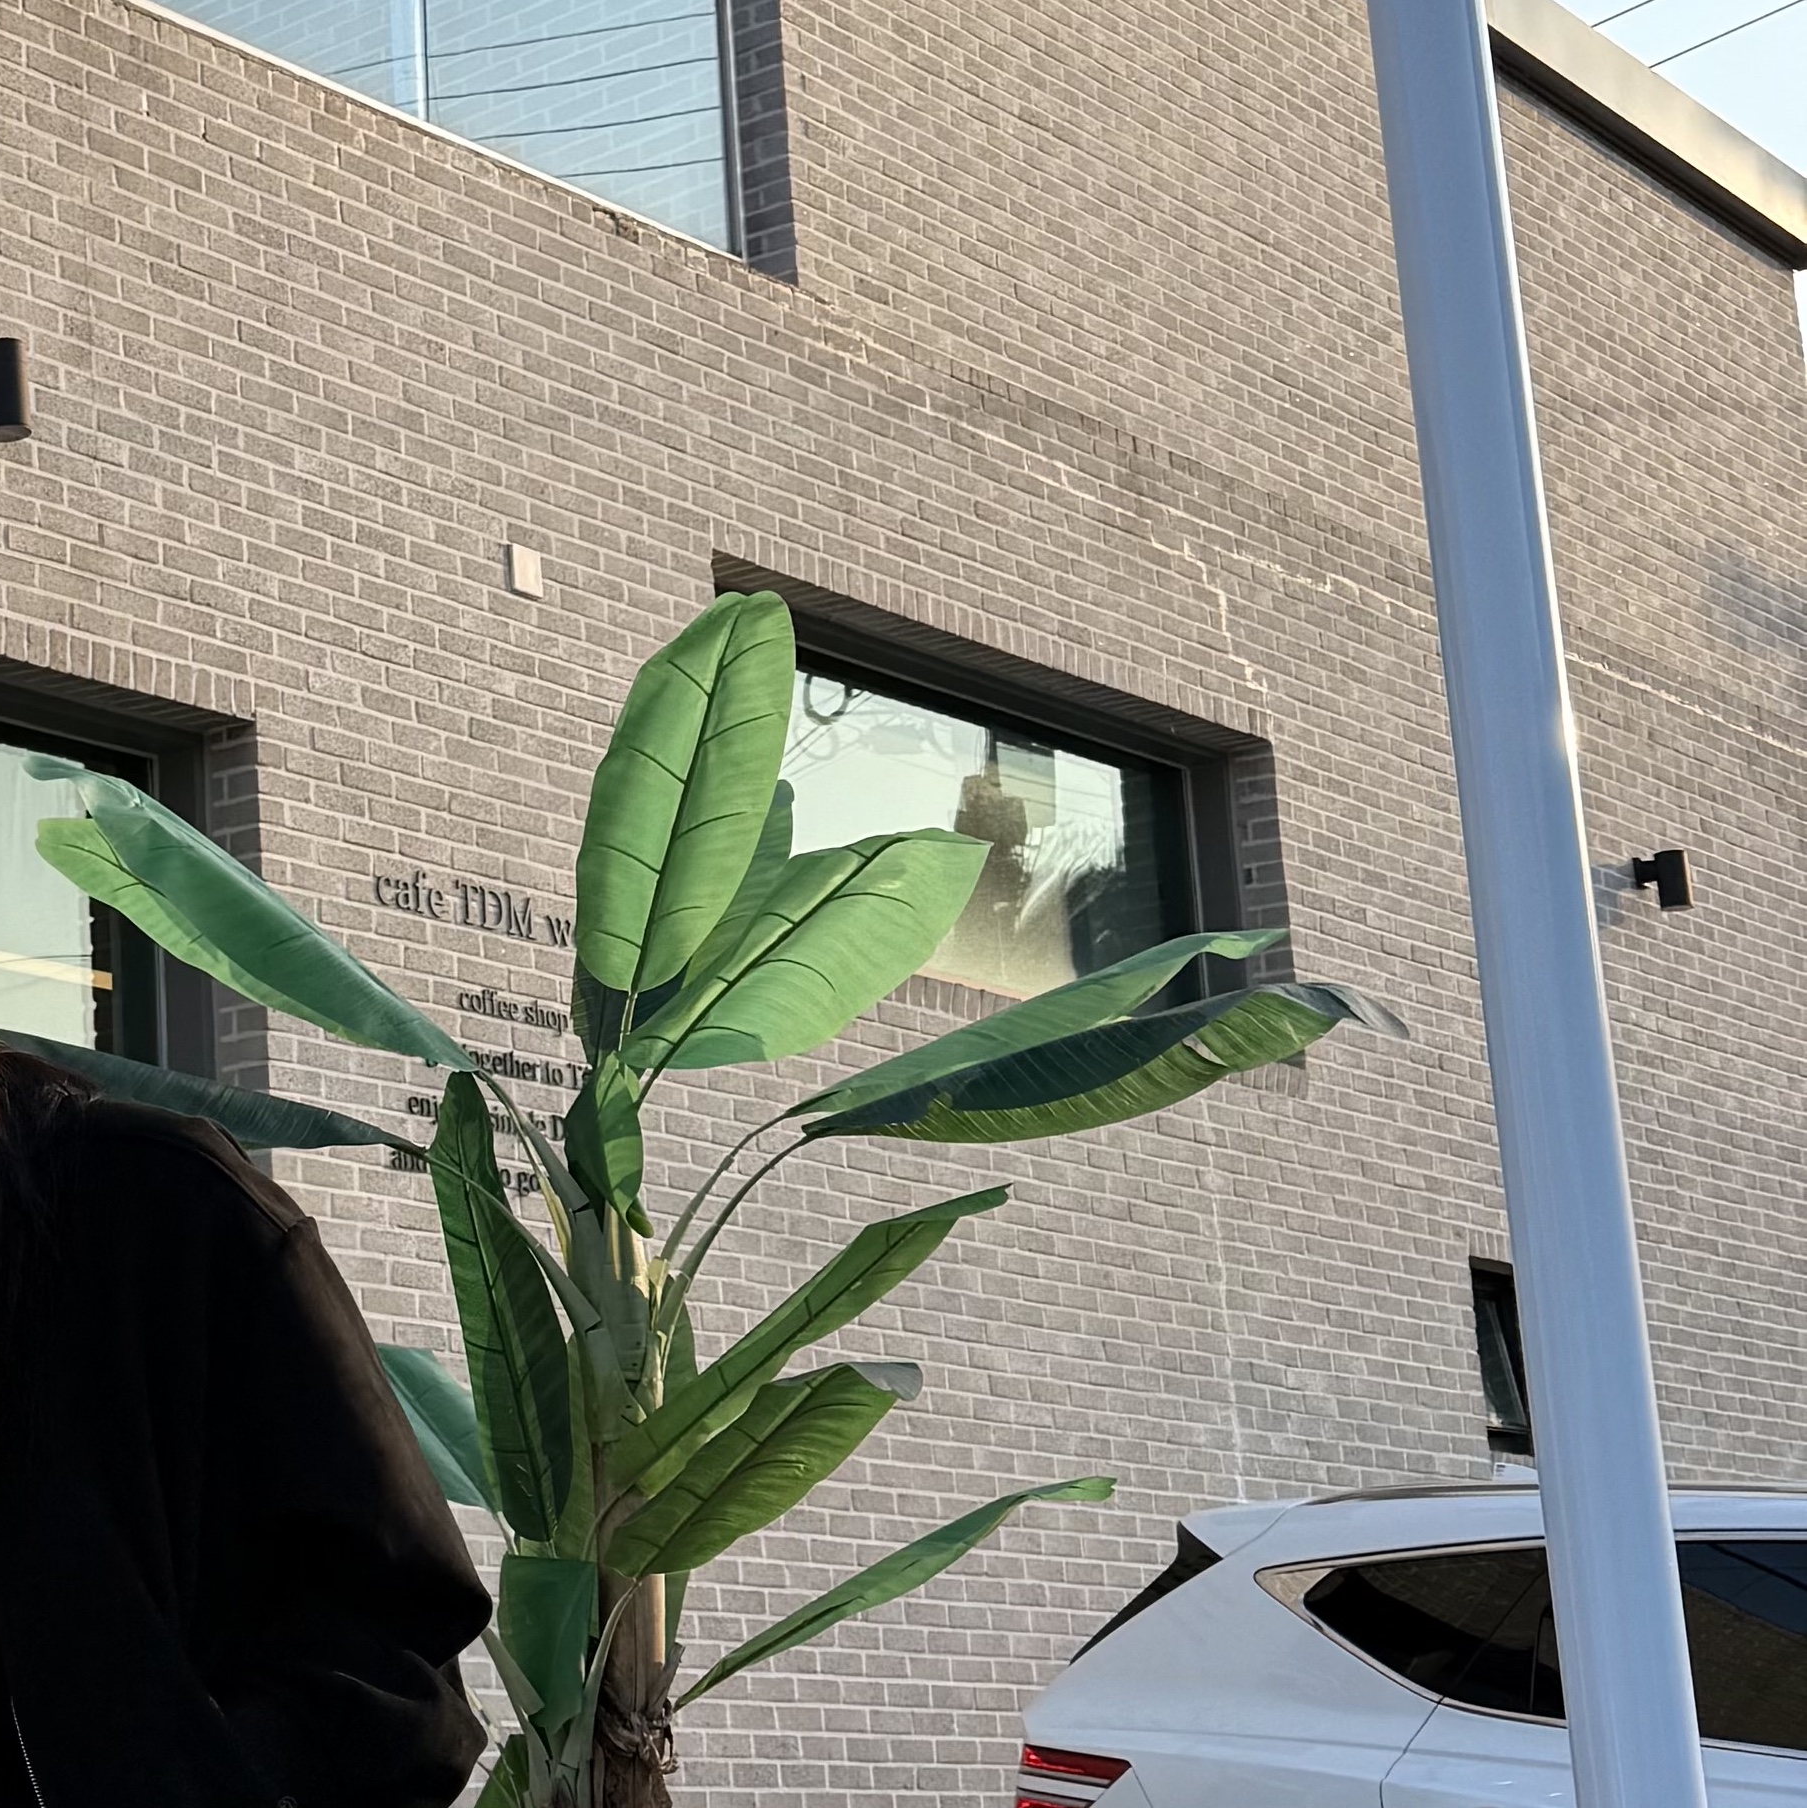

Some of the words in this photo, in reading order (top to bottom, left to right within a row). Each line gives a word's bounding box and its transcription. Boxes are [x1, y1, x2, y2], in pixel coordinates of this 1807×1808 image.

[376, 870, 445, 919] cafe
[454, 879, 537, 941] TDM
[459, 989, 520, 1022] coffee
[524, 1000, 569, 1037] shop
[462, 1044, 541, 1082] ogether
[543, 1060, 564, 1086] to
